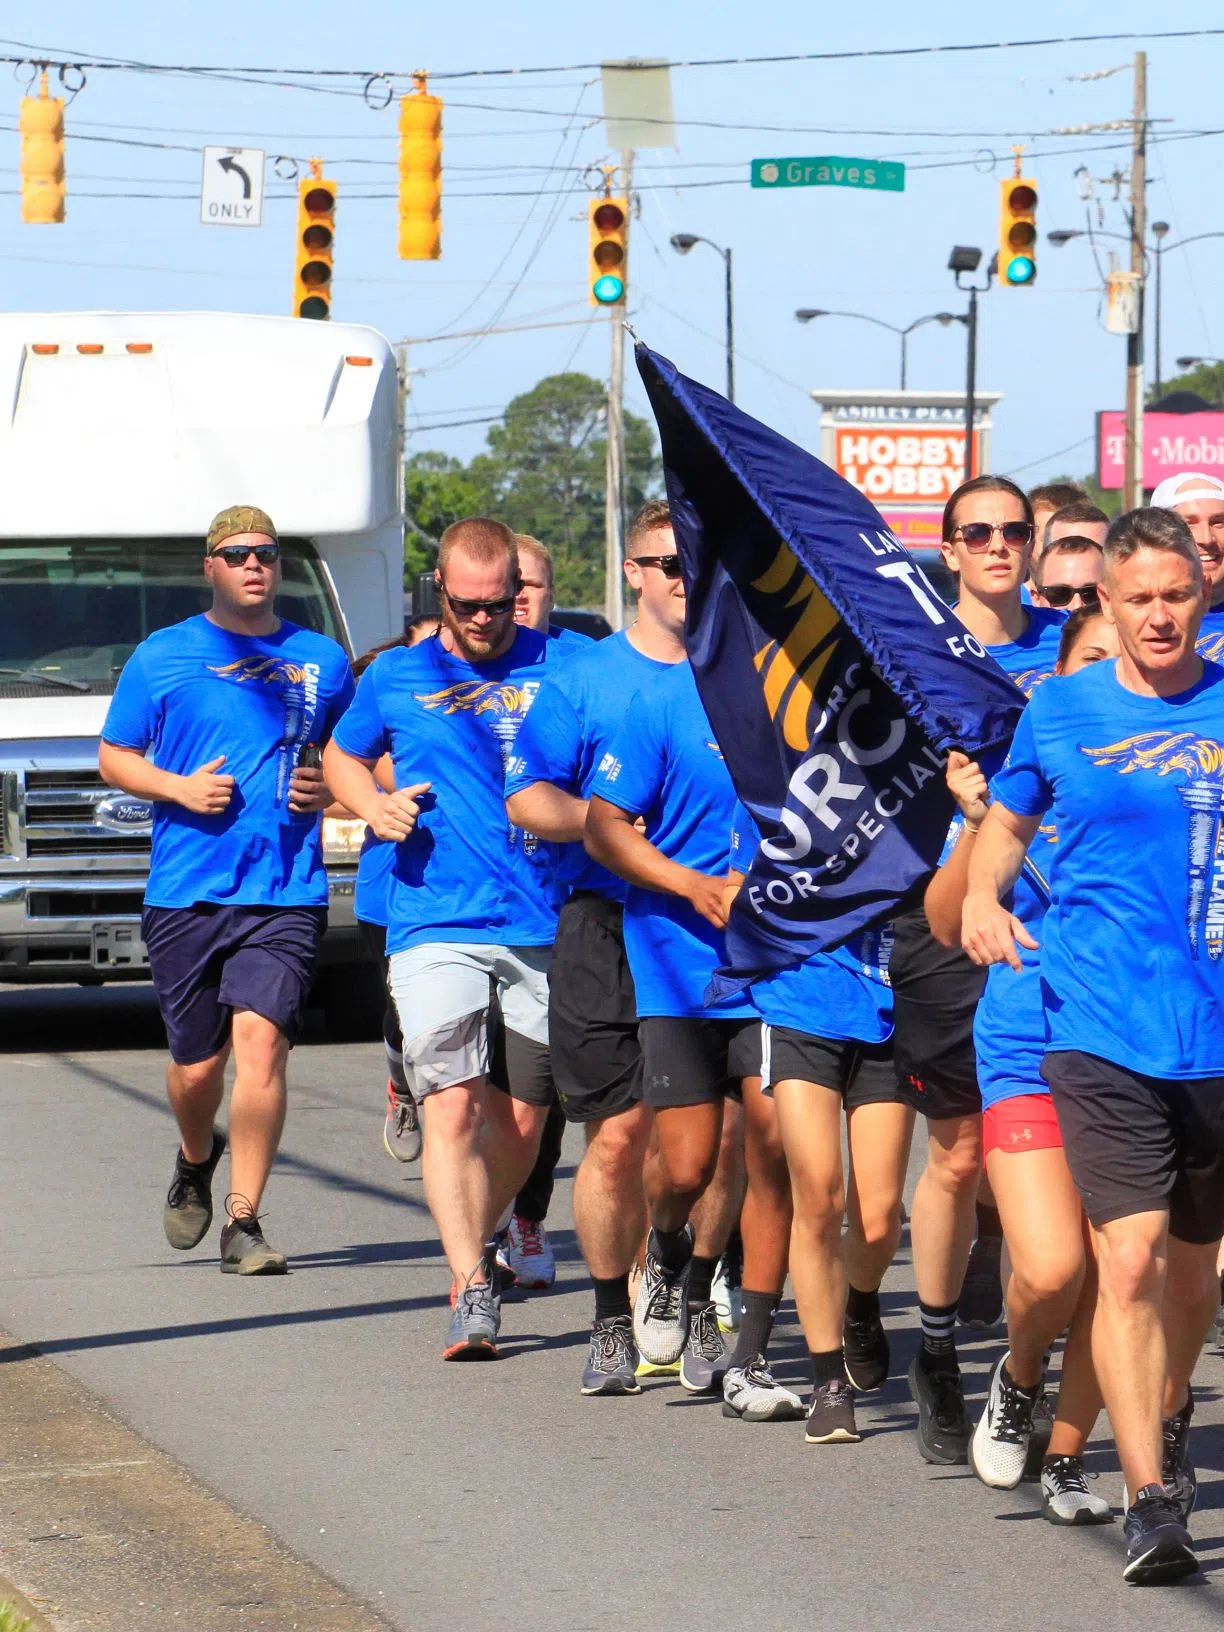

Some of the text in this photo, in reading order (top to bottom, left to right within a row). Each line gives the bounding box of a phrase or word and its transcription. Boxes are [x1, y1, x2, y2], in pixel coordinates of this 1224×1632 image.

[786, 161, 877, 185] Graves
[208, 202, 253, 219] ONLY
[835, 406, 911, 420] ASHLEY
[840, 435, 966, 466] HOBBY
[843, 465, 965, 495] LOBBY
[946, 633, 989, 658] FO
[304, 662, 320, 716] CARRY
[118, 804, 150, 820] Ford
[748, 746, 949, 915] FOR SPECIAL
